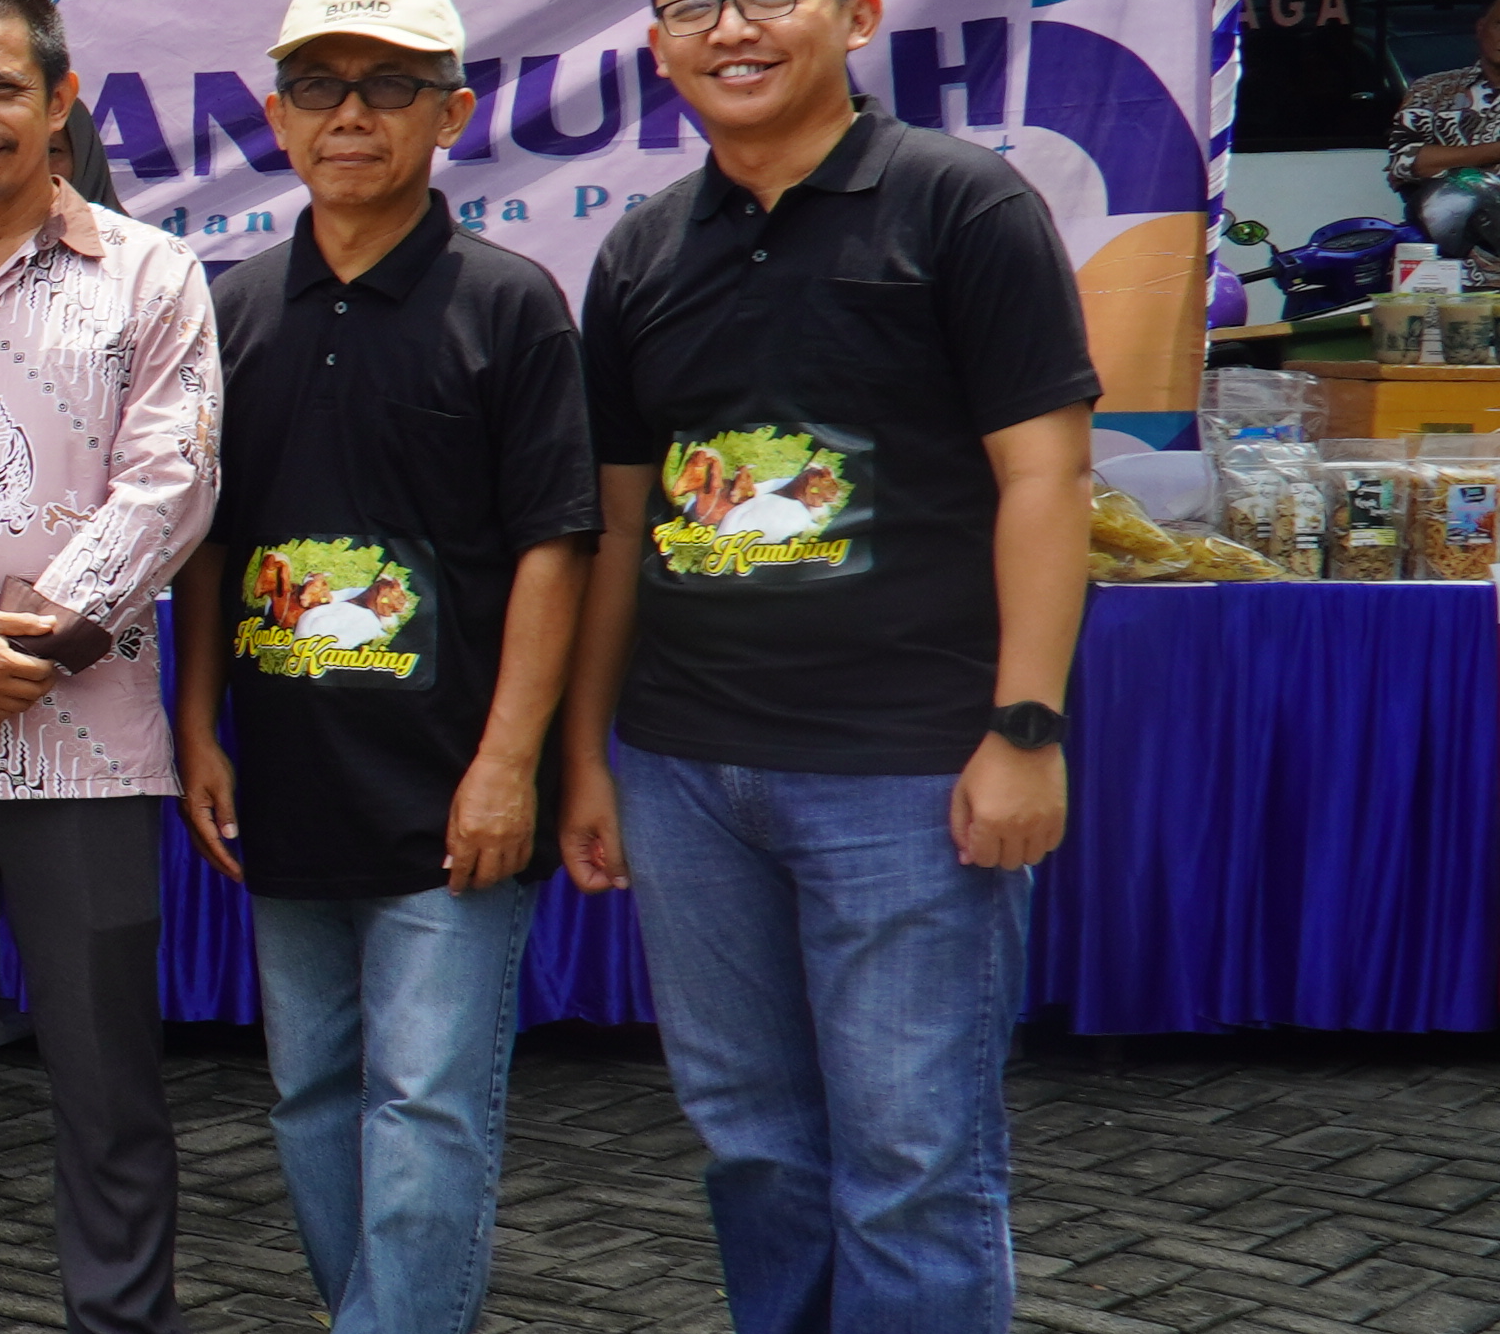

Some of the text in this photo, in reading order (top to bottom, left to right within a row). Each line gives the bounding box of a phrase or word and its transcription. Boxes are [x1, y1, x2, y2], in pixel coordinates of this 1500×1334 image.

[325, 0, 392, 17] BUMD
[162, 206, 276, 237] dan
[704, 529, 853, 577] Kambing
[234, 615, 421, 679] Kontes Kambing
